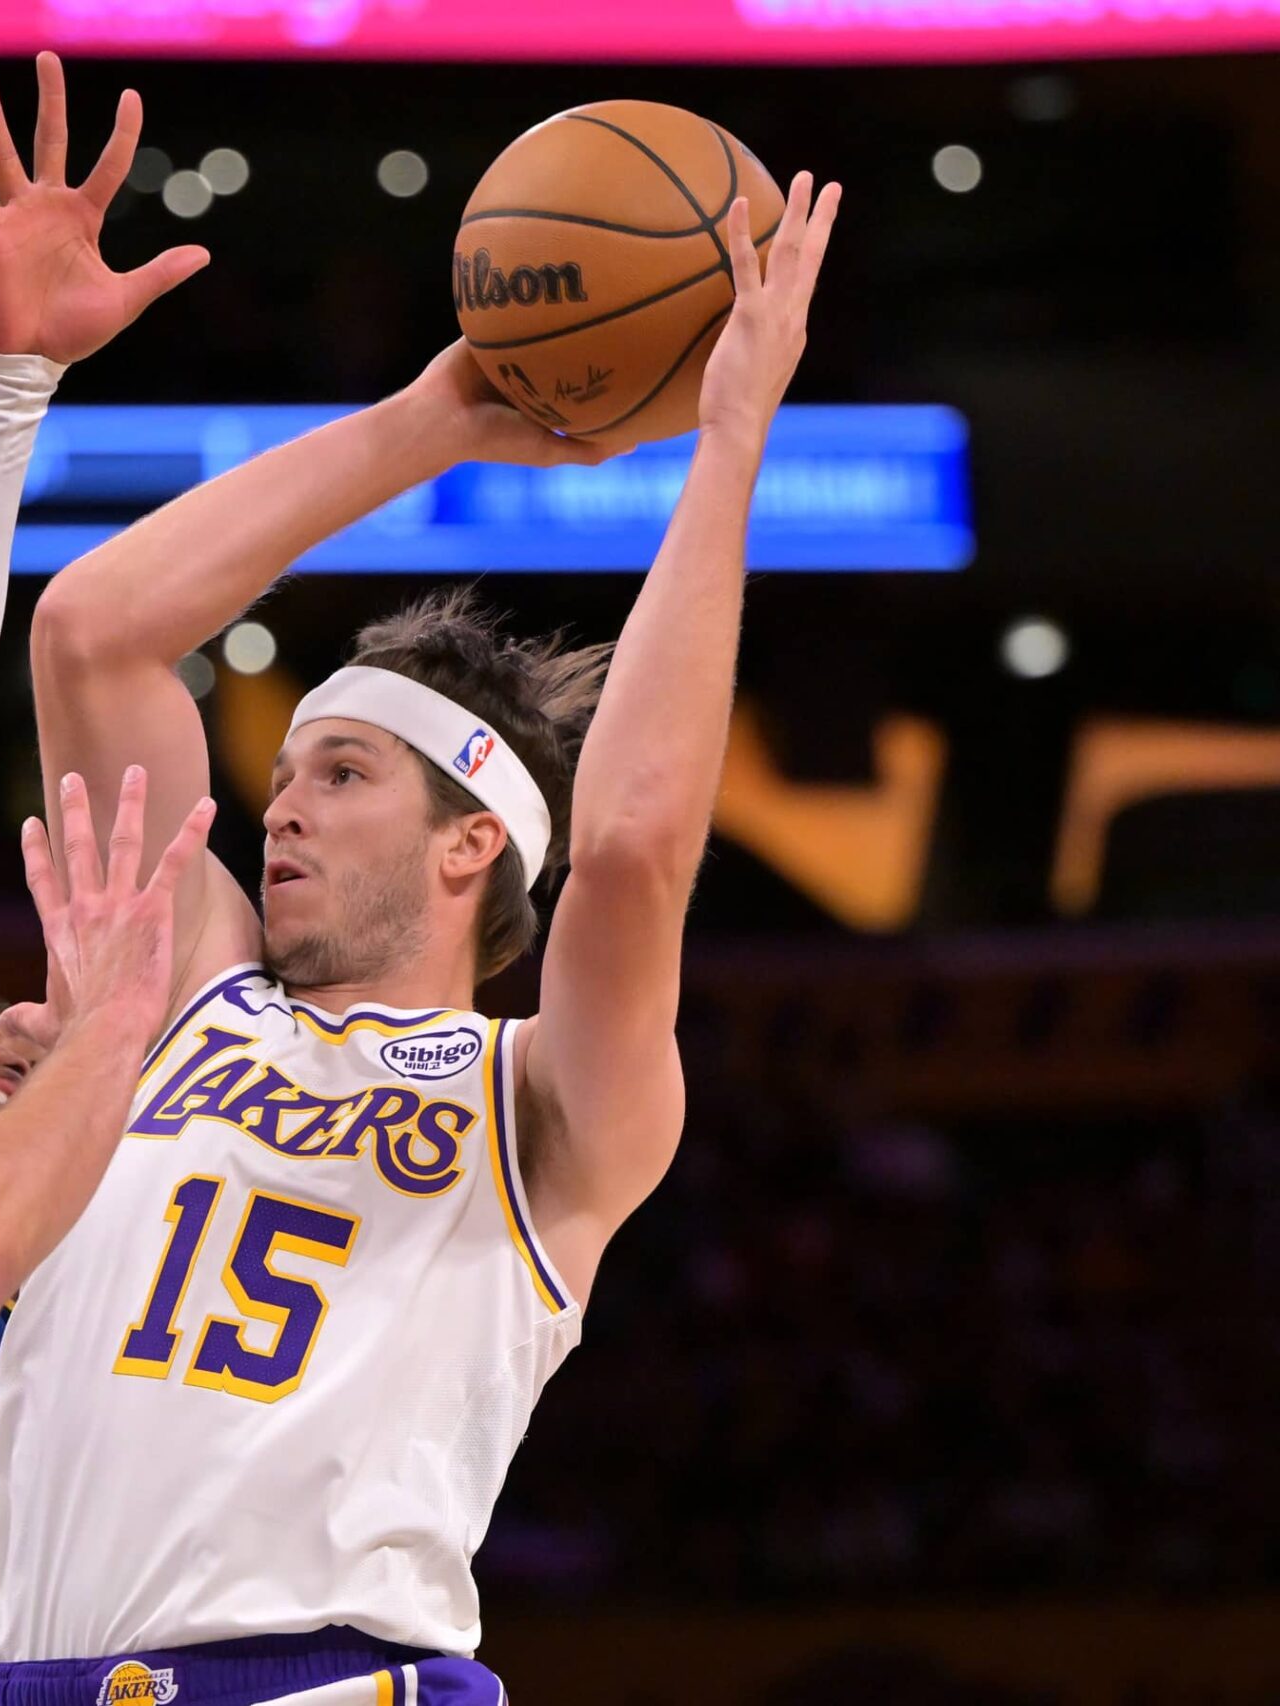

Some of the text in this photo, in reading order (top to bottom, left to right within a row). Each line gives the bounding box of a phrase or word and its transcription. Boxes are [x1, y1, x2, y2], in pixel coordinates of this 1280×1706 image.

[453, 247, 588, 313] ilson
[391, 1042, 476, 1064] bibigo
[404, 1061, 441, 1071] 비비고
[124, 1024, 480, 1198] LAKERS
[112, 1173, 363, 1404] 15
[102, 1678, 174, 1706] LAKERS
